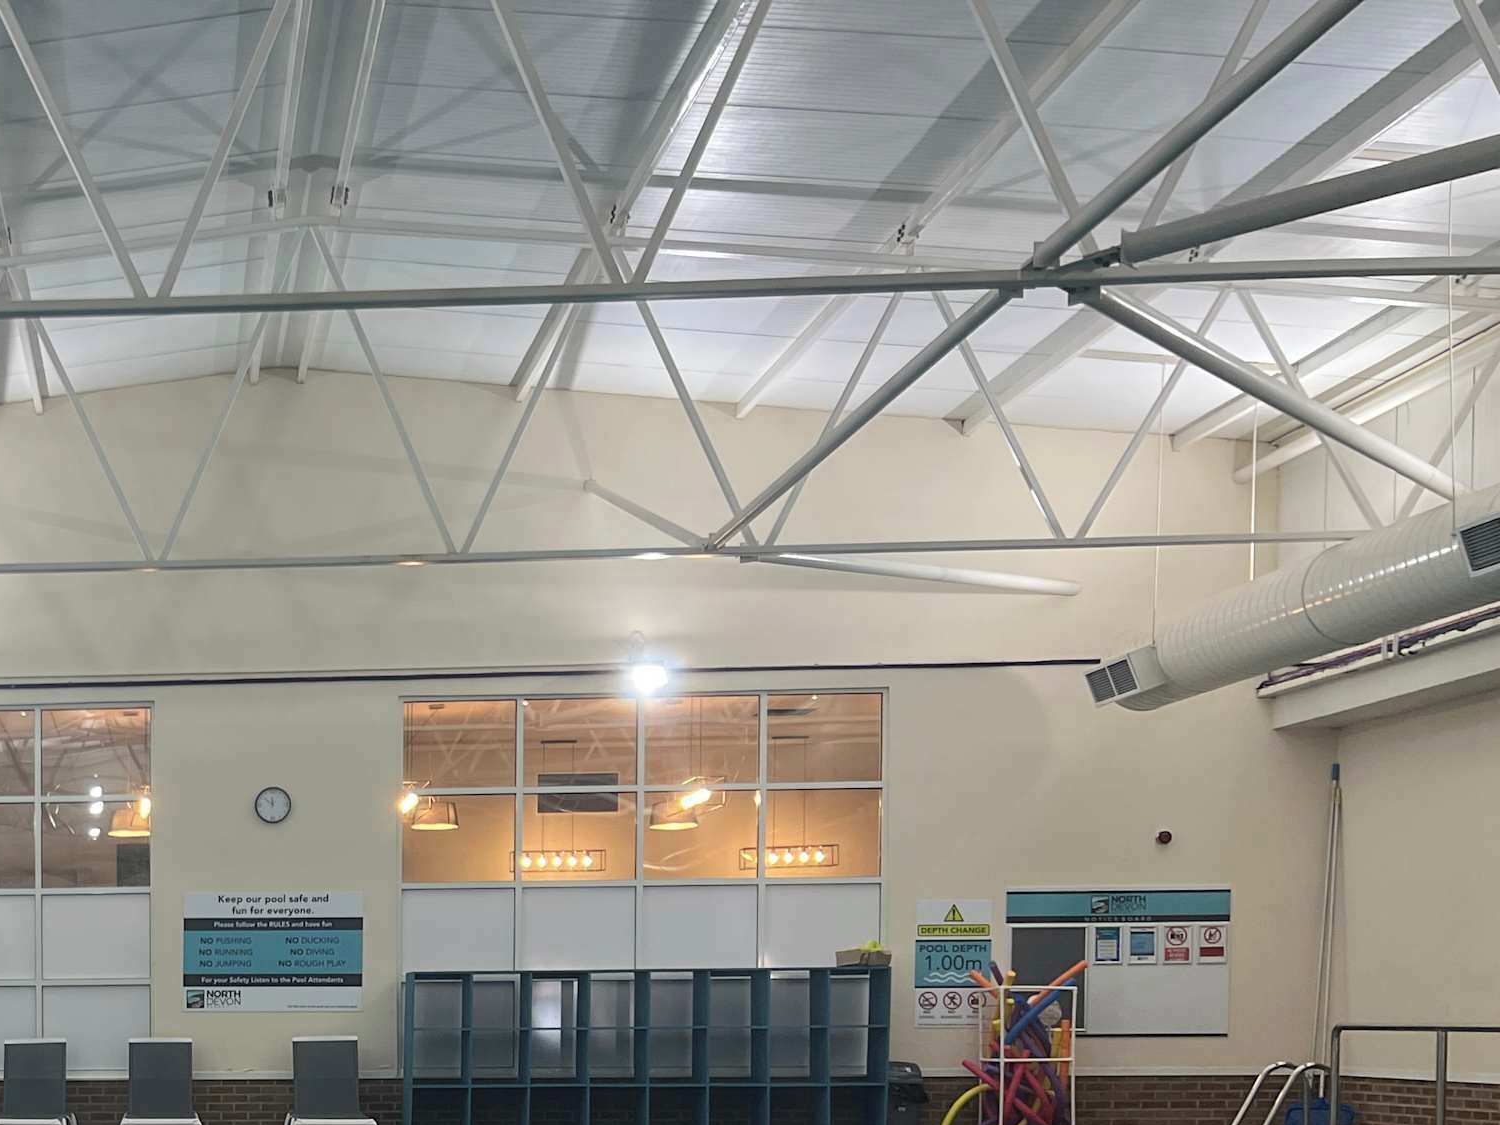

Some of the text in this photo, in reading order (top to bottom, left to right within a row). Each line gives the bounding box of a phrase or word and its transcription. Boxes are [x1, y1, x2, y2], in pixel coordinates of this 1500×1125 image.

[218, 894, 243, 905] Keep
[265, 894, 286, 905] pool
[289, 894, 309, 903] safe
[312, 893, 329, 903] and
[232, 906, 315, 916] fun for everyone.
[950, 926, 987, 934] CHANGE
[200, 936, 214, 945] NO
[285, 936, 340, 945] NO DUCKING
[199, 948, 213, 956] NO
[290, 948, 304, 956] NO
[919, 944, 987, 953] POOL DEPTH
[199, 960, 213, 968] NO
[278, 960, 292, 968] NO
[925, 954, 982, 971] 1.00m
[206, 990, 241, 998] NORTH
[206, 998, 241, 1006] DEVON
